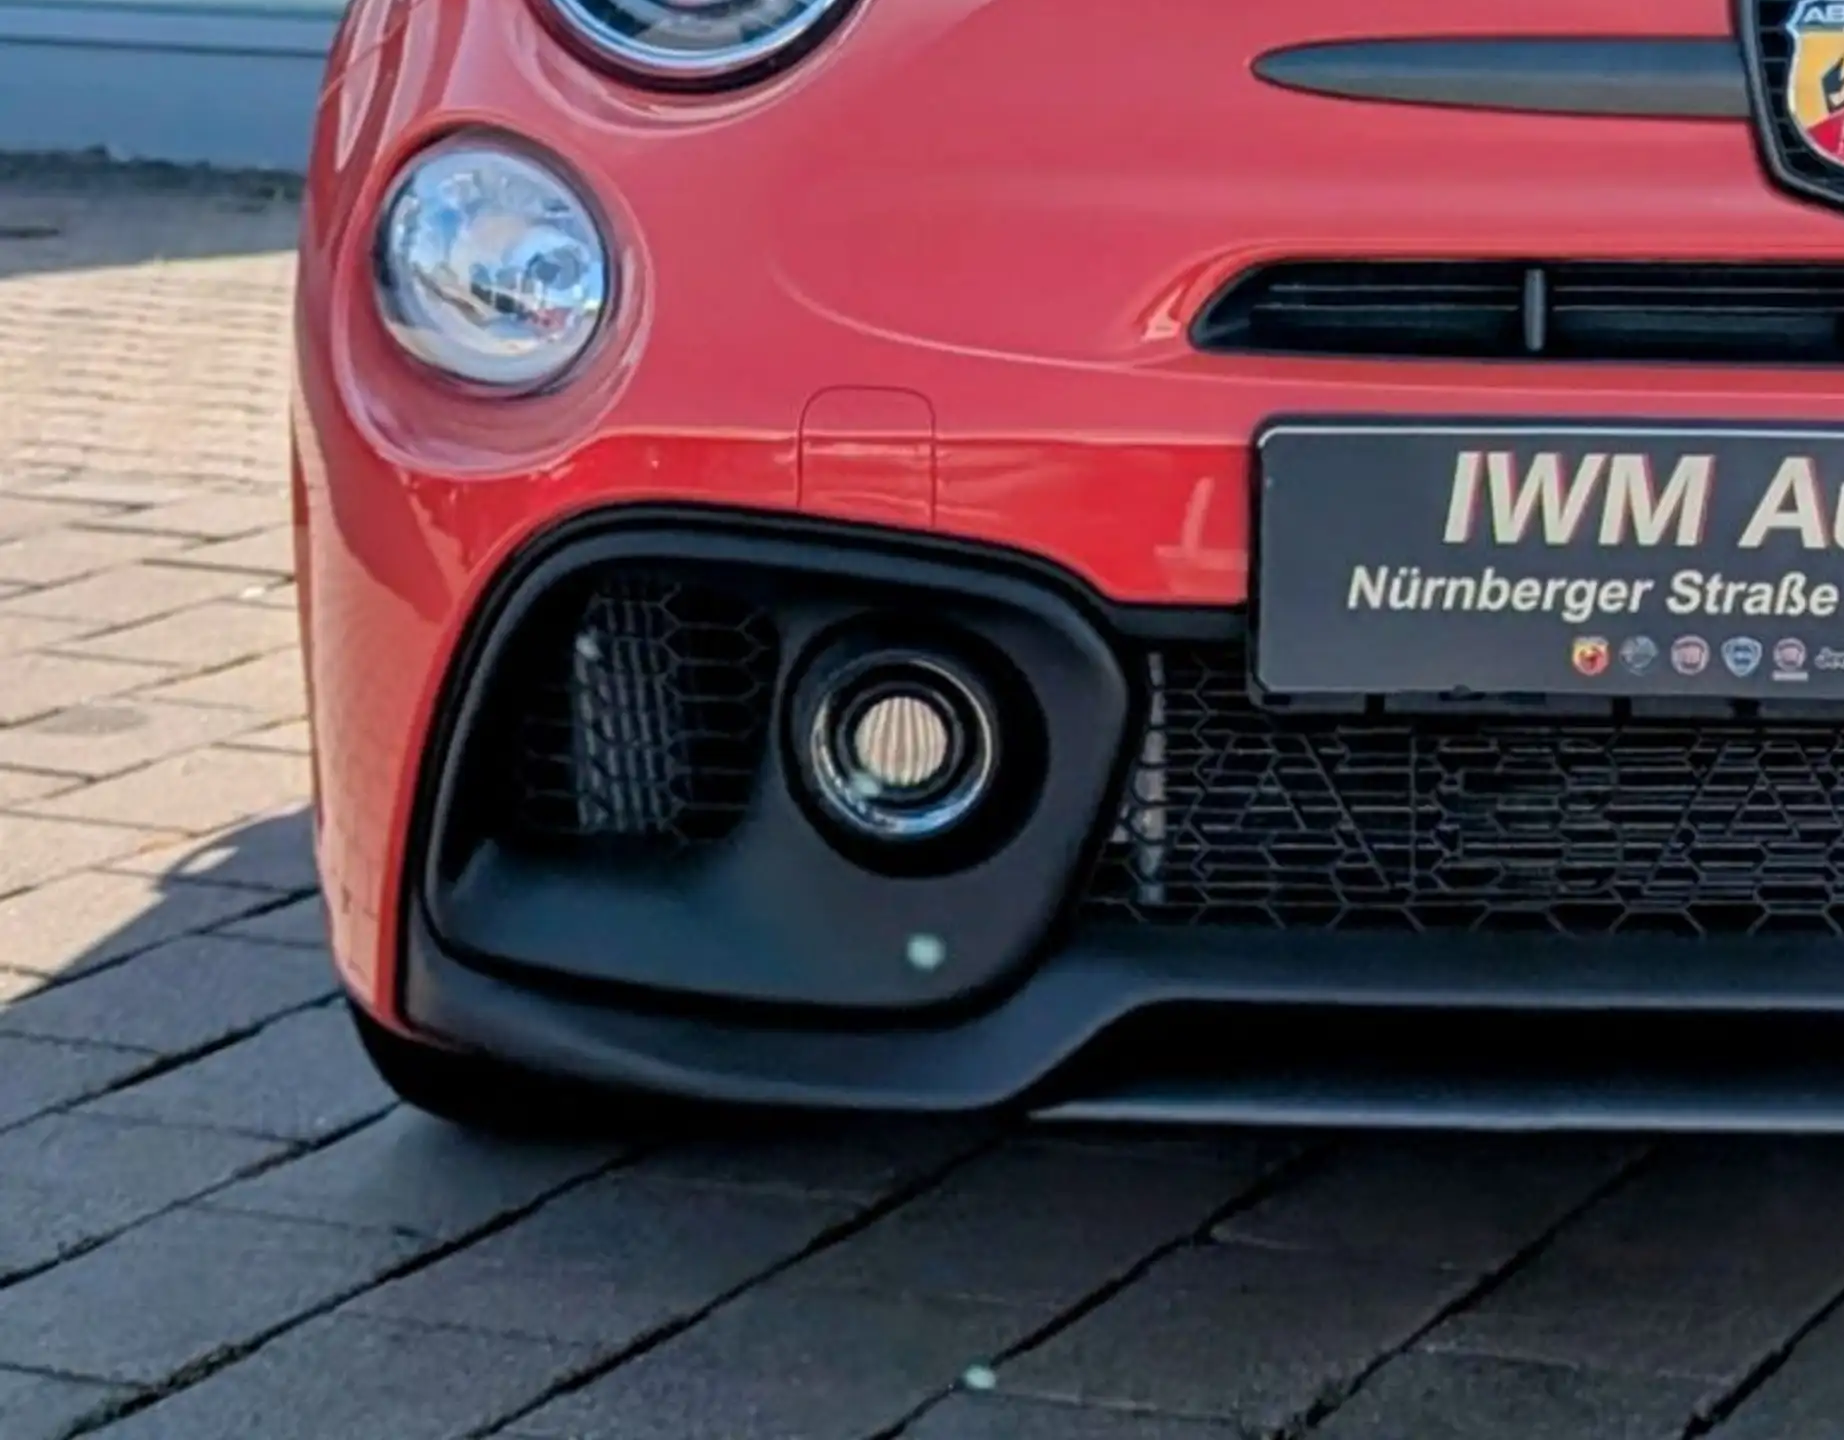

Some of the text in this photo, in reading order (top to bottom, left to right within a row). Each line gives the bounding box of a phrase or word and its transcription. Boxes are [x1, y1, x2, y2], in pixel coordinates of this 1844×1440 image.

[1443, 451, 1715, 547] IWM
[1347, 565, 1655, 624] Nürnberger
[1665, 569, 1841, 618] Straße
